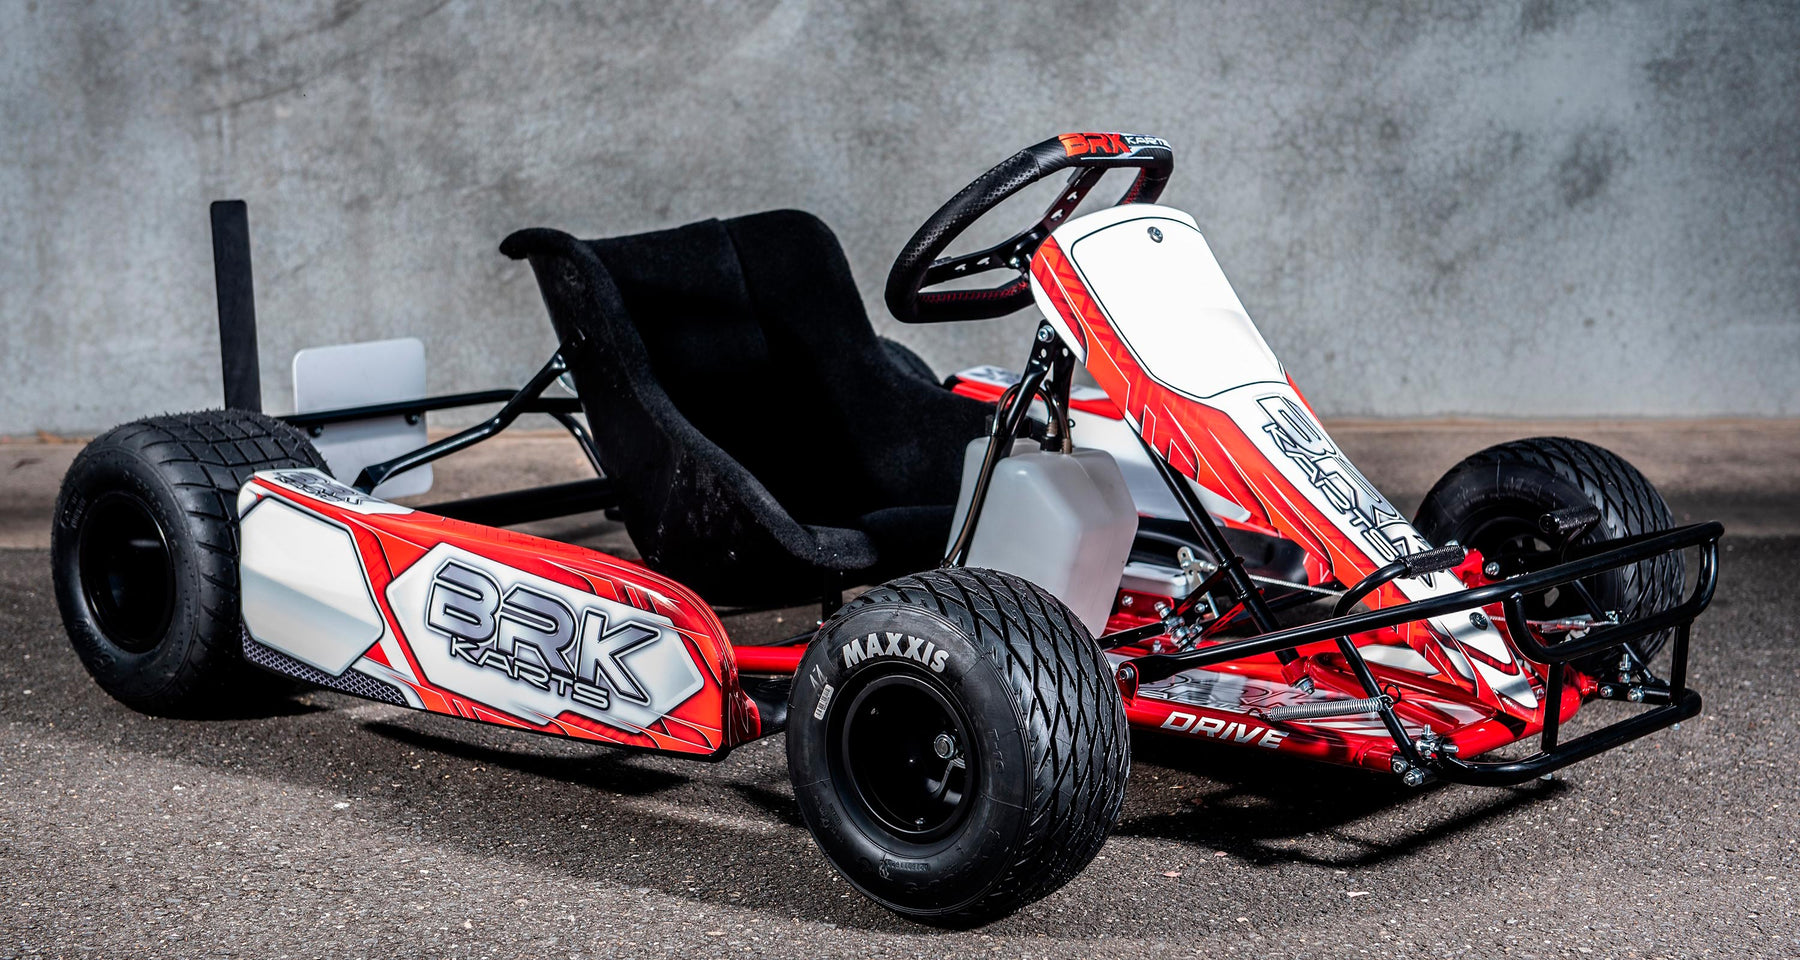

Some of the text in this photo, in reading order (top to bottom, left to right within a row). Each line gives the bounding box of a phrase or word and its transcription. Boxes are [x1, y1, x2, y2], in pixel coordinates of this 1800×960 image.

[1058, 132, 1132, 157] BRK
[1262, 422, 1401, 563] KARTS
[426, 558, 662, 707] BRK
[842, 632, 950, 673] MAXXIS
[450, 634, 610, 711] KARTS
[1160, 711, 1290, 749] DRIVE
